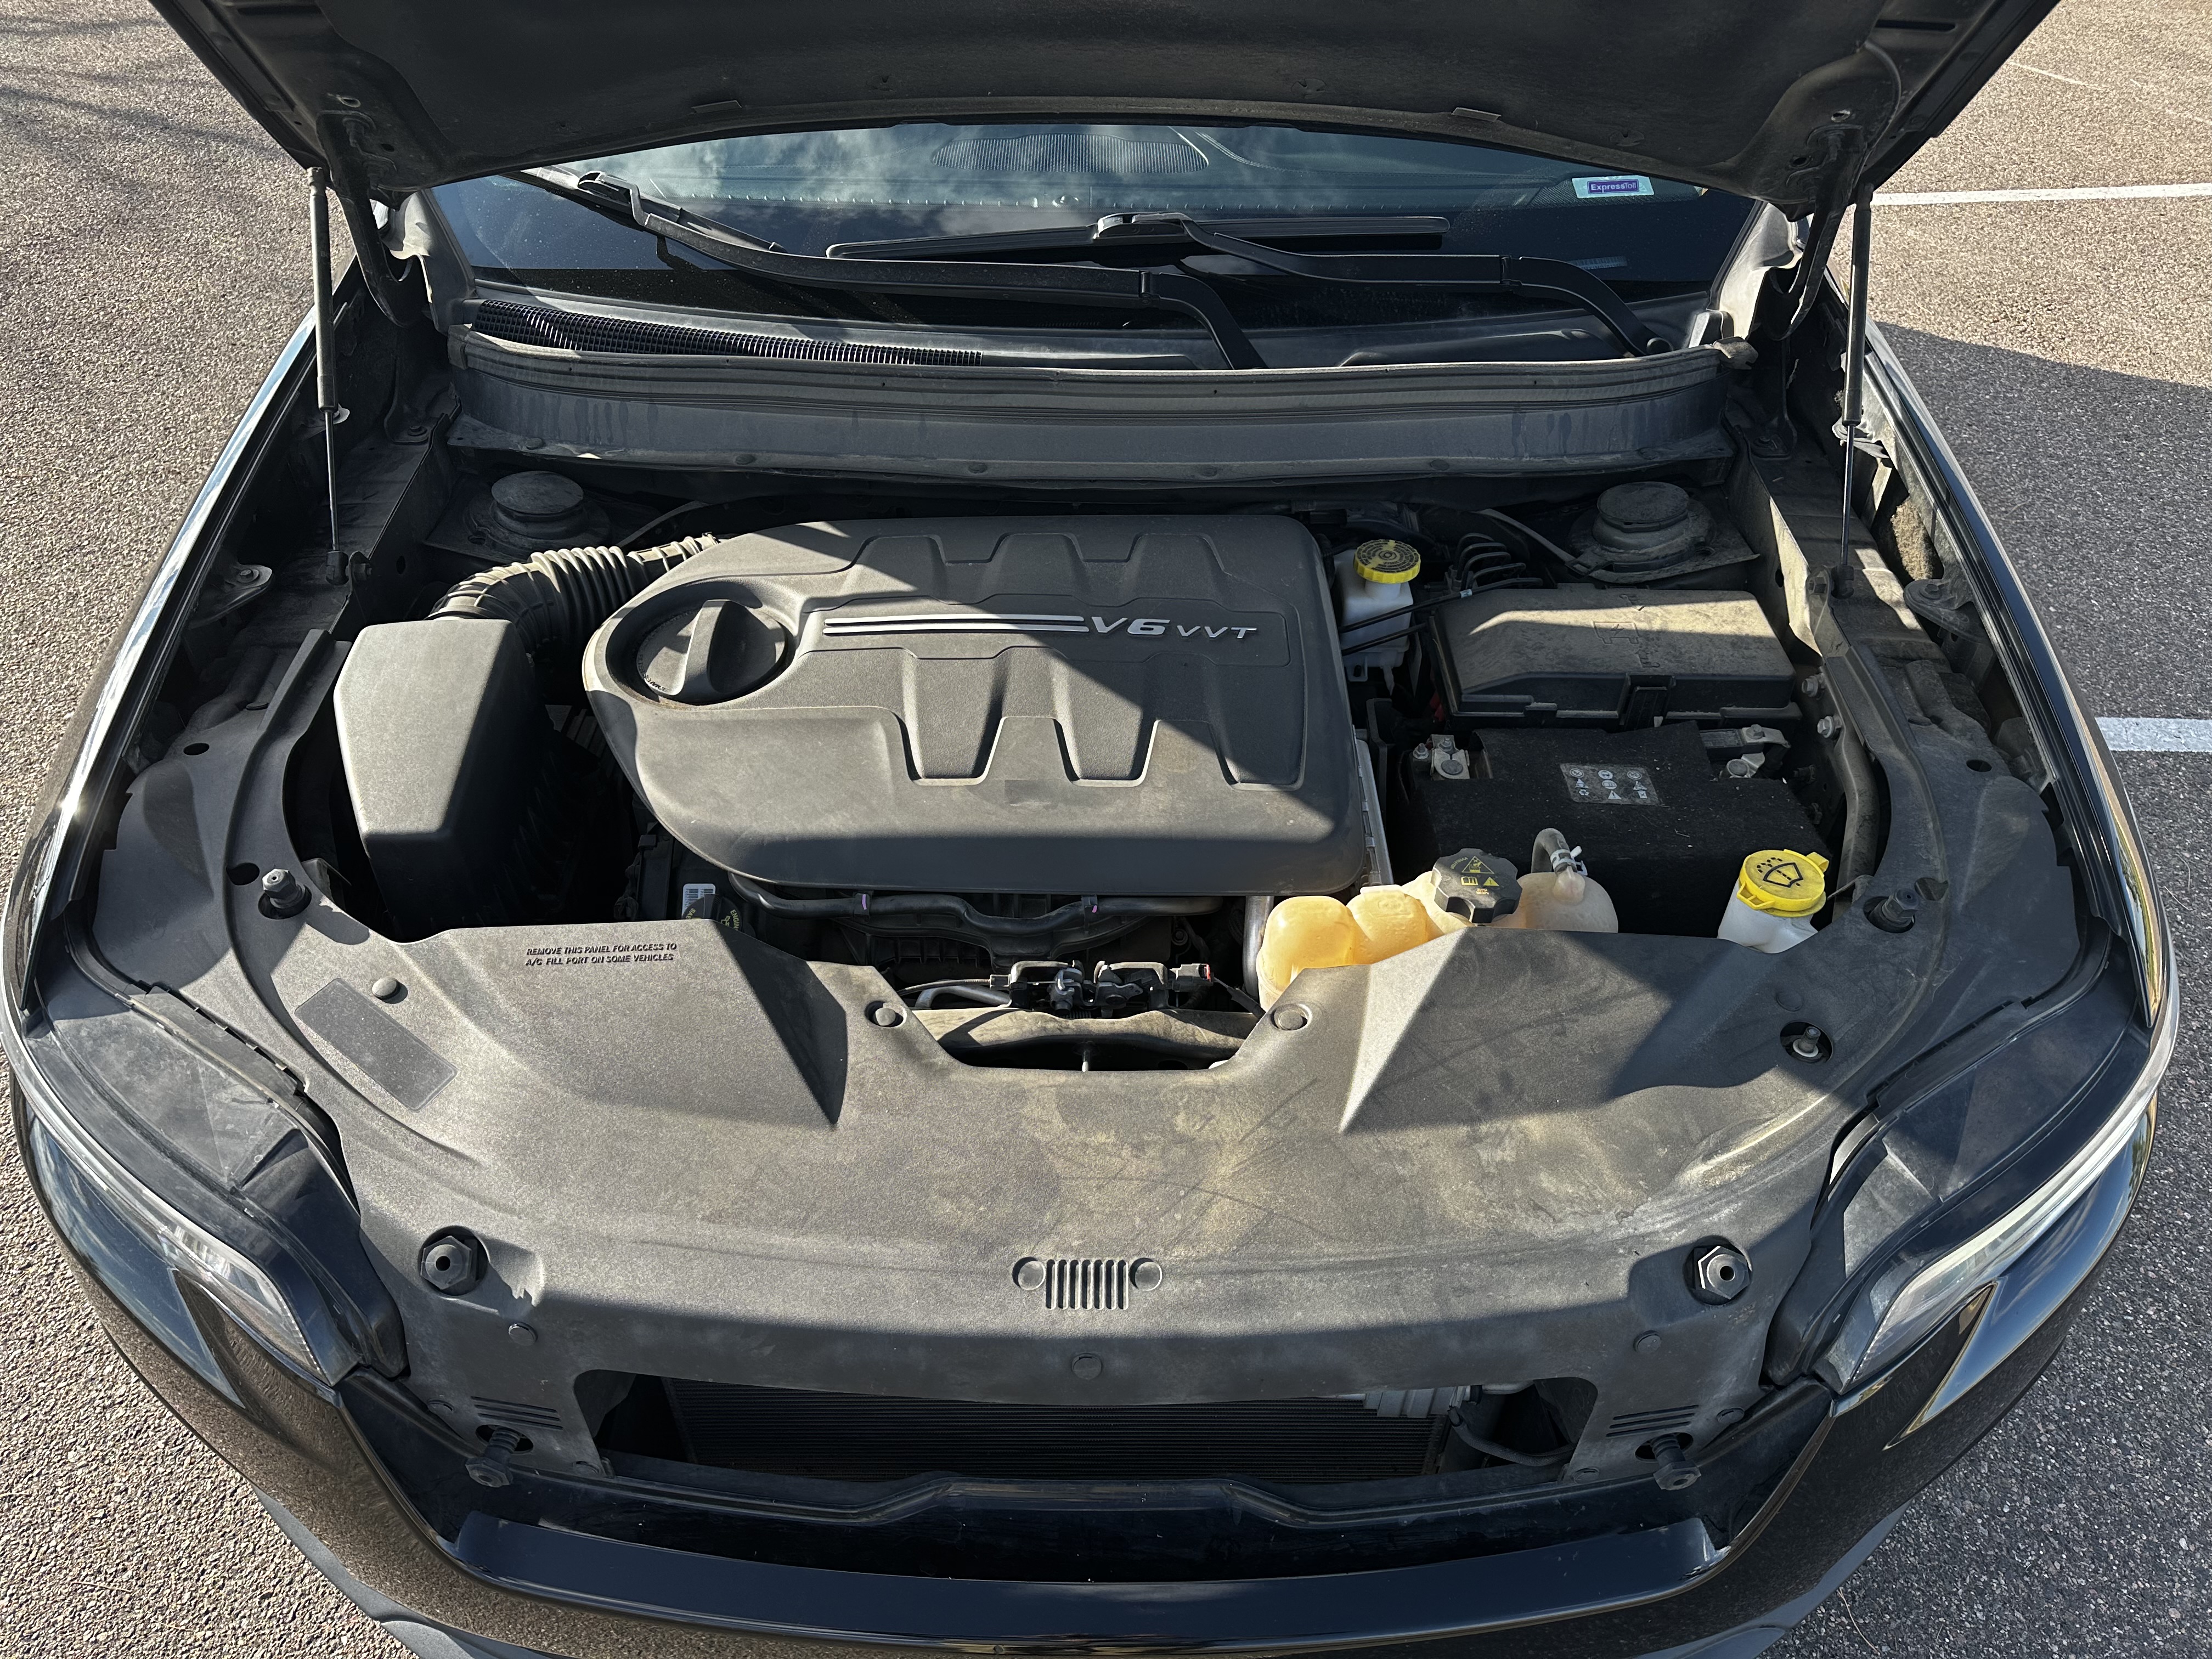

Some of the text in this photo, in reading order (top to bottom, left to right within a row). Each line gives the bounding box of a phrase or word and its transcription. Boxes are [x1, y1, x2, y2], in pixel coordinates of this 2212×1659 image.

[1591, 182, 1637, 193] ExpressToll
[1091, 616, 1257, 639] V6 VVT
[686, 908, 696, 919] SAE
[730, 909, 740, 931] ENGIN
[526, 947, 562, 956] REMOVE
[563, 946, 583, 955] THIS
[584, 945, 611, 953] PANEL
[612, 944, 630, 952] FOR
[631, 943, 664, 952] ACCESS
[525, 958, 543, 966] A/C
[566, 956, 589, 964] PORT
[634, 953, 674, 962] VEHICLES
